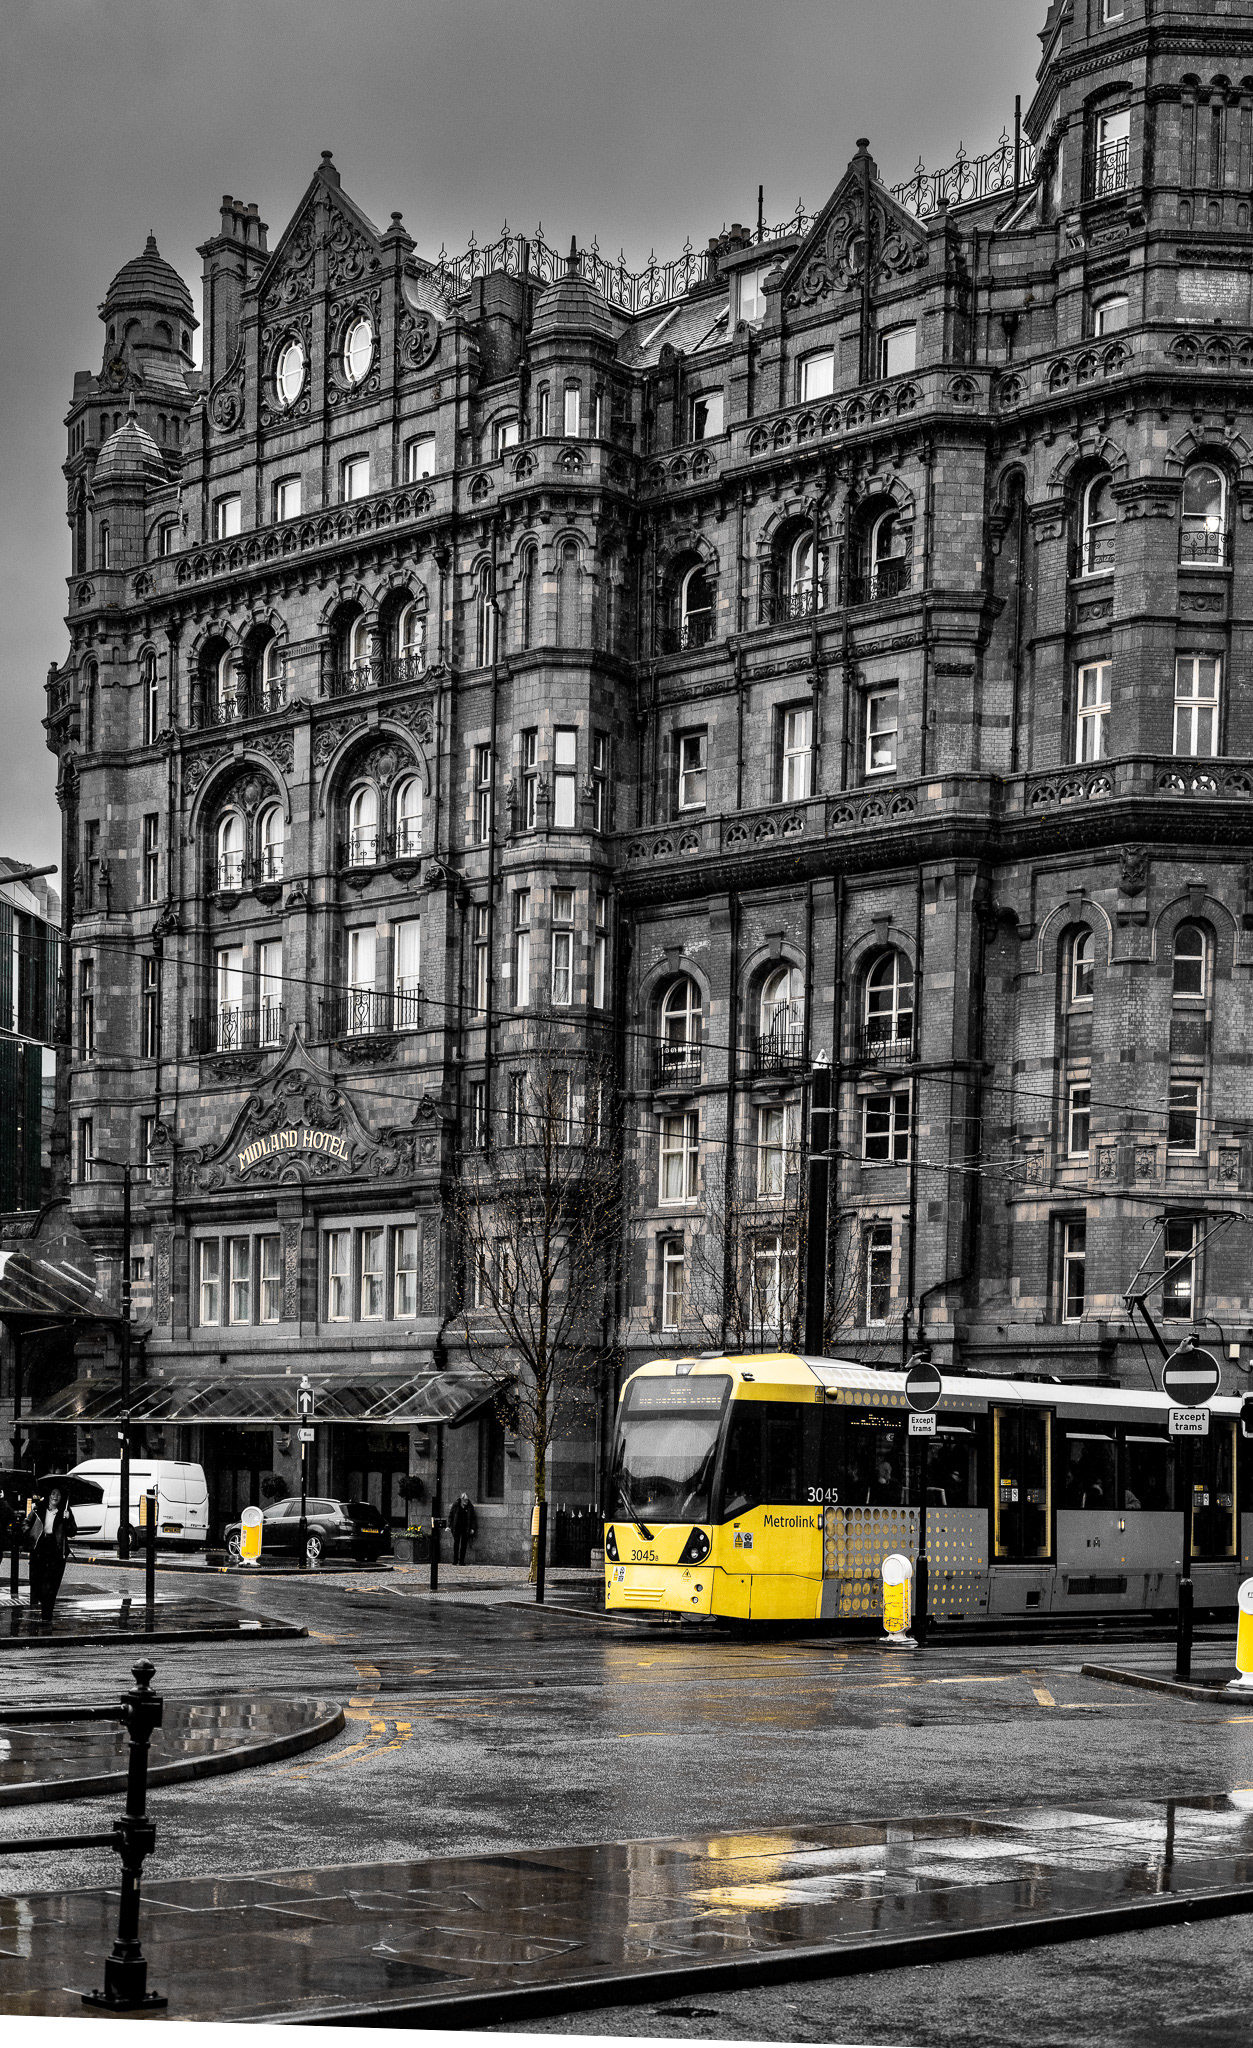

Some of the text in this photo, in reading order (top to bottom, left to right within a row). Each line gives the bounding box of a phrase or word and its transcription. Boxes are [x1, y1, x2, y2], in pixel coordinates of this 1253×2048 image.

[237, 1129, 349, 1171] MIDLAND HOTEL
[911, 1416, 934, 1424] Except
[1173, 1412, 1206, 1422] Except
[807, 1486, 839, 1503] 3045
[763, 1514, 816, 1528] Metrolink
